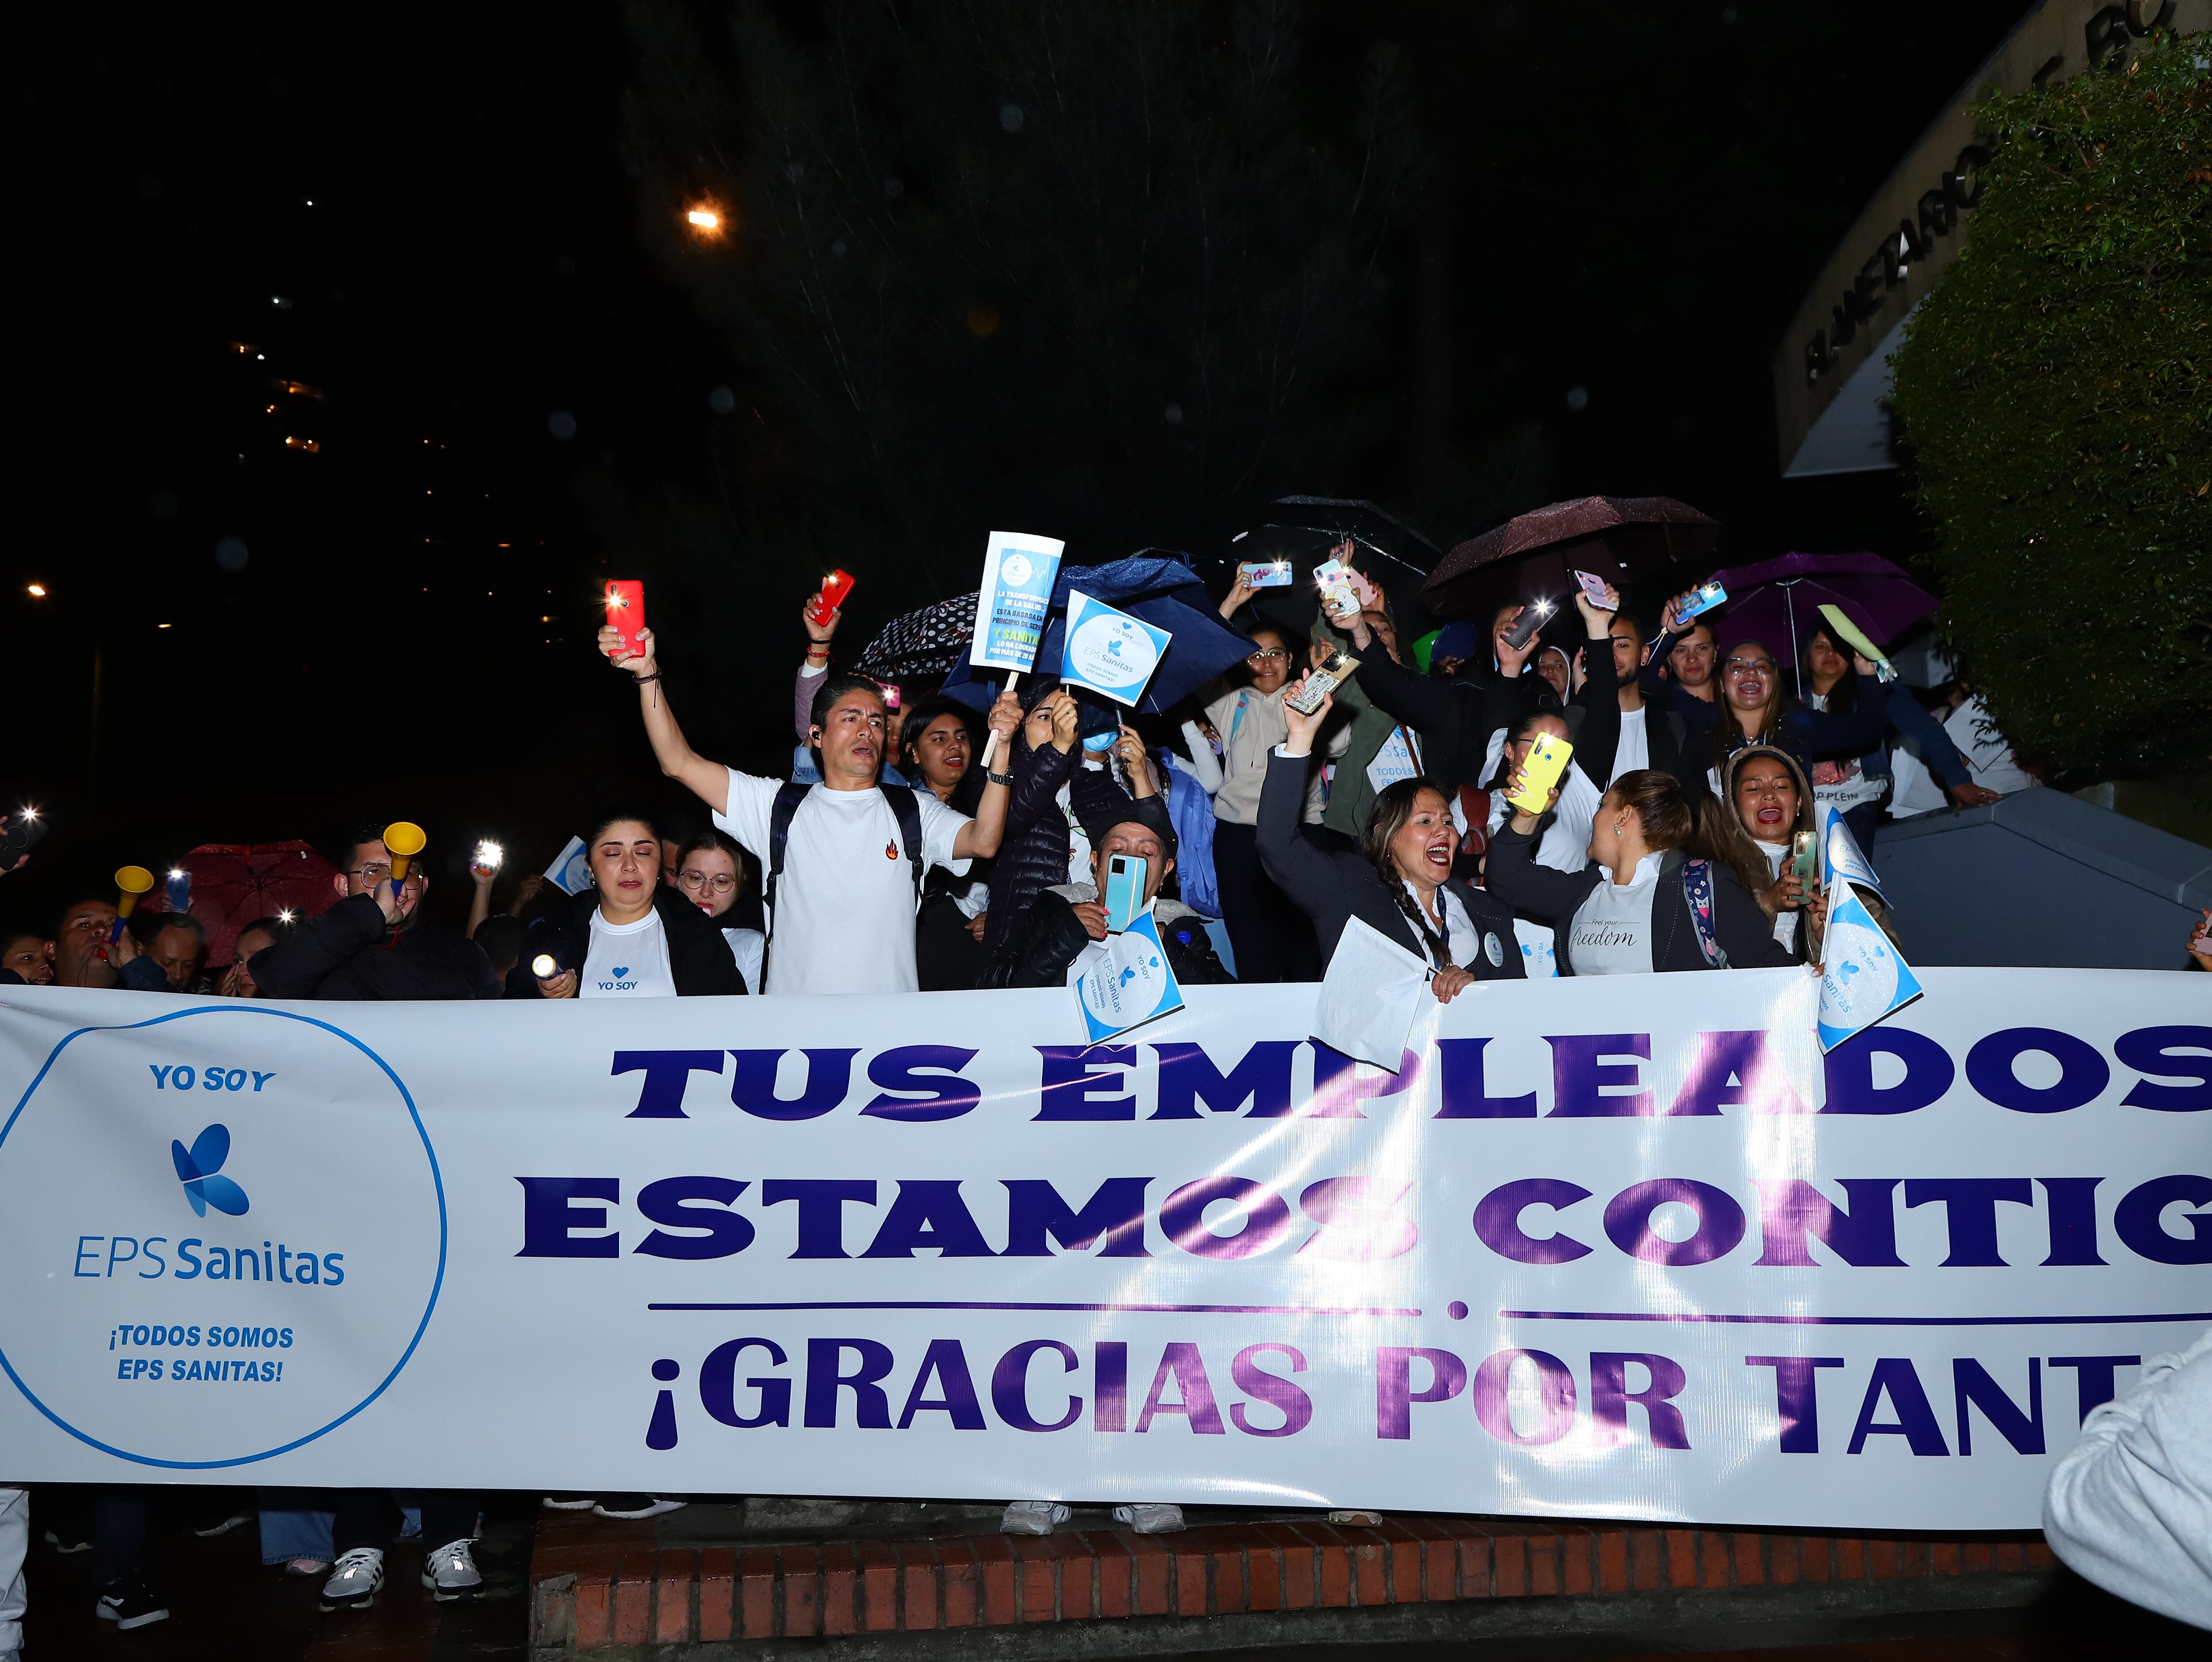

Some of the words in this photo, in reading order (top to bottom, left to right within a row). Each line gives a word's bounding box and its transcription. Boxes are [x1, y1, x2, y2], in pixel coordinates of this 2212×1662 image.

[1023, 601, 1045, 612] SALUD...
[1012, 610, 1036, 621] BASADA
[992, 617, 1020, 626] PRINCIPIO
[995, 628, 1001, 637] Y
[1121, 631, 1134, 640] SOY
[1001, 648, 1014, 656] MÁS
[1015, 642, 1037, 653] LOGRADO
[1094, 672, 1115, 682] SANITAS!
[1102, 668, 1118, 678] SOMOS
[1376, 768, 1408, 776] TODOS
[1826, 792, 1859, 801] PLEIN
[1570, 926, 1638, 952] freedom
[1538, 941, 1544, 950] YO
[1137, 954, 1144, 965] YO
[1141, 966, 1151, 980] SOY
[1865, 957, 1879, 972] SOY
[598, 982, 614, 990] YO
[615, 981, 638, 990] SOY
[1091, 988, 1100, 1009] SANITAS!
[149, 1064, 196, 1092] YO
[202, 1065, 276, 1092] SOY
[610, 1044, 982, 1122] TUS
[1029, 1025, 2212, 1121] EMPLEADOS
[513, 1175, 1419, 1262] ESTAMOS
[1473, 1174, 2212, 1267] CONTIG
[73, 1236, 167, 1279] EPS
[174, 1237, 345, 1286] Sanitas
[109, 1324, 201, 1351] ¡TODOS
[207, 1326, 294, 1349] SOMOS
[117, 1359, 164, 1380] EPS
[171, 1360, 283, 1382] SANITAS!
[645, 1337, 1313, 1451] ¡GRACIAS
[1376, 1346, 1693, 1451] POR
[1745, 1355, 2142, 1457] TANT
